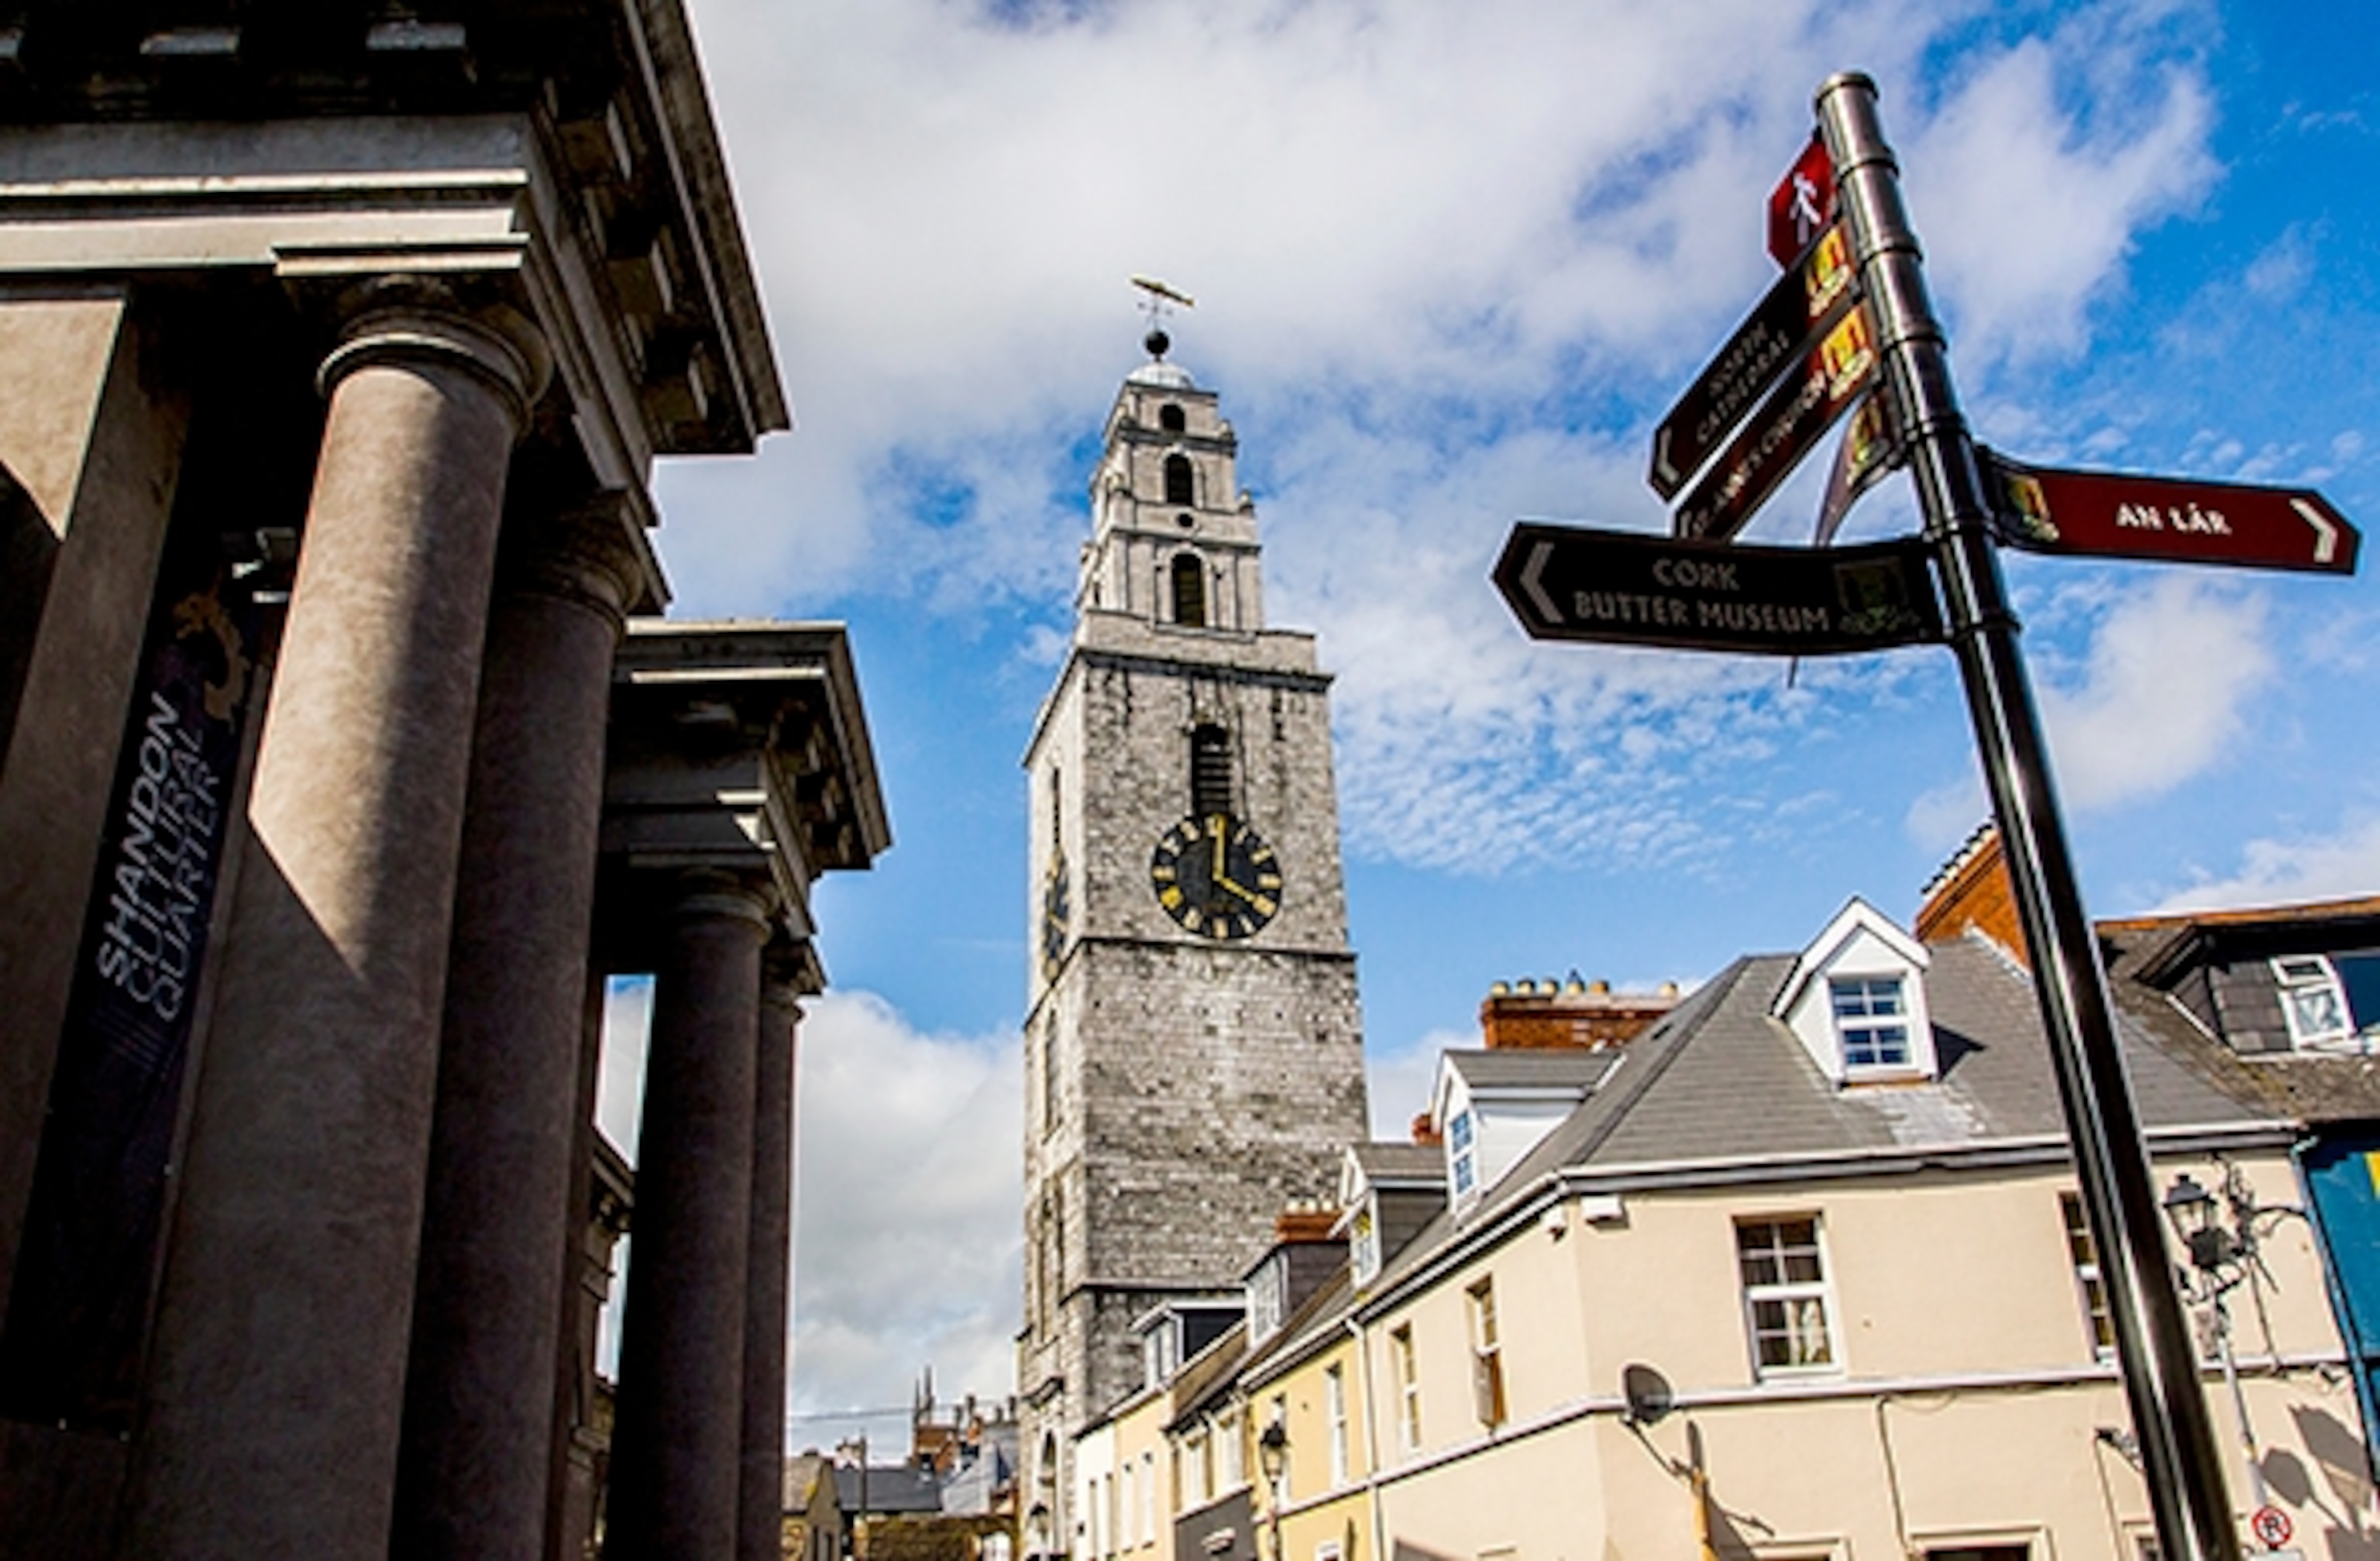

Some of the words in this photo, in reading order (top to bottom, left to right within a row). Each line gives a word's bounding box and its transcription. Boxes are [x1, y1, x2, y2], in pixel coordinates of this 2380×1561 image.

[1652, 558, 1741, 591] CORK
[2115, 502, 2165, 531] AN
[2168, 502, 2234, 536] LÁR
[1573, 590, 1690, 625] BUTTER
[1697, 598, 1831, 633] MUSEUM
[98, 691, 181, 986] SHANDON
[126, 727, 201, 1004] CULTURAL
[153, 762, 221, 1022] QUARTER
